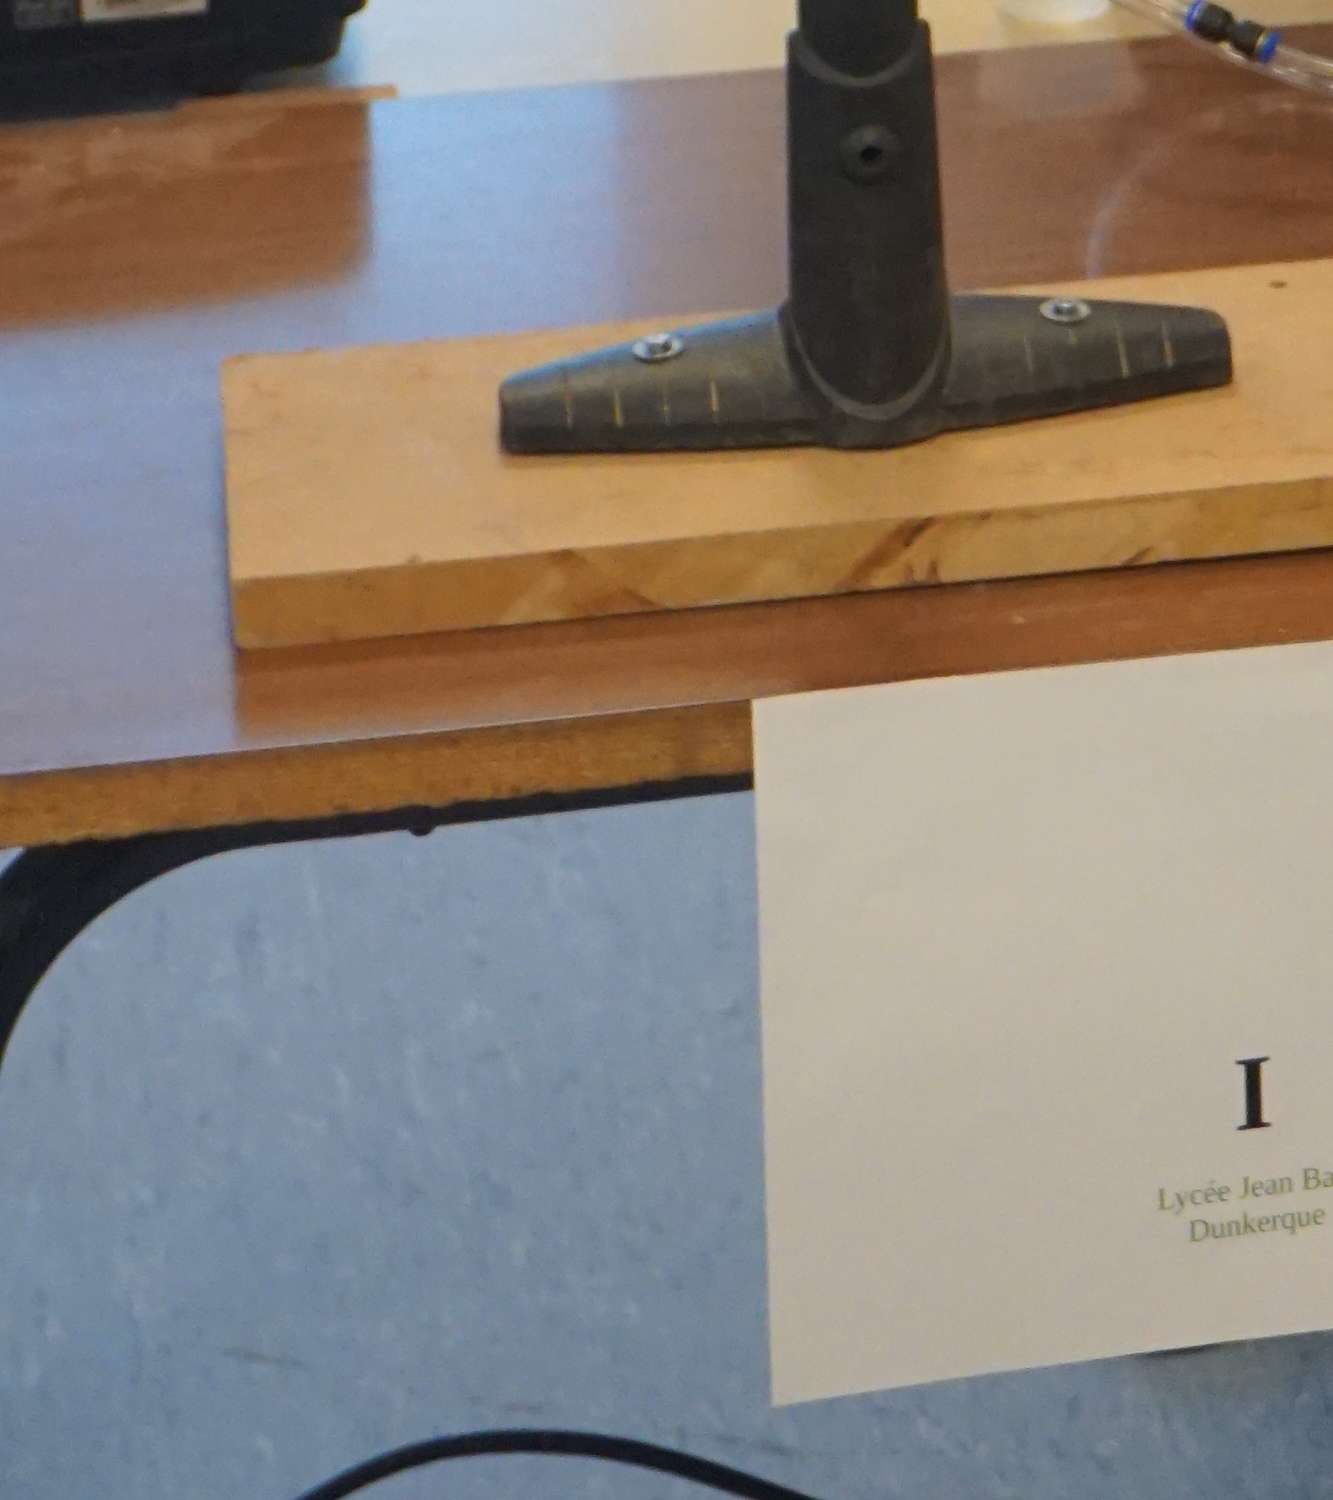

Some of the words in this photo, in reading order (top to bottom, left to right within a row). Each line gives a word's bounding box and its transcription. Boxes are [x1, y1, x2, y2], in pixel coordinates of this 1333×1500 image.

[1235, 1056, 1272, 1131] I
[1157, 1179, 1231, 1215] Lycée
[1239, 1175, 1294, 1200] Jean
[1188, 1207, 1327, 1243] Dunkerque
